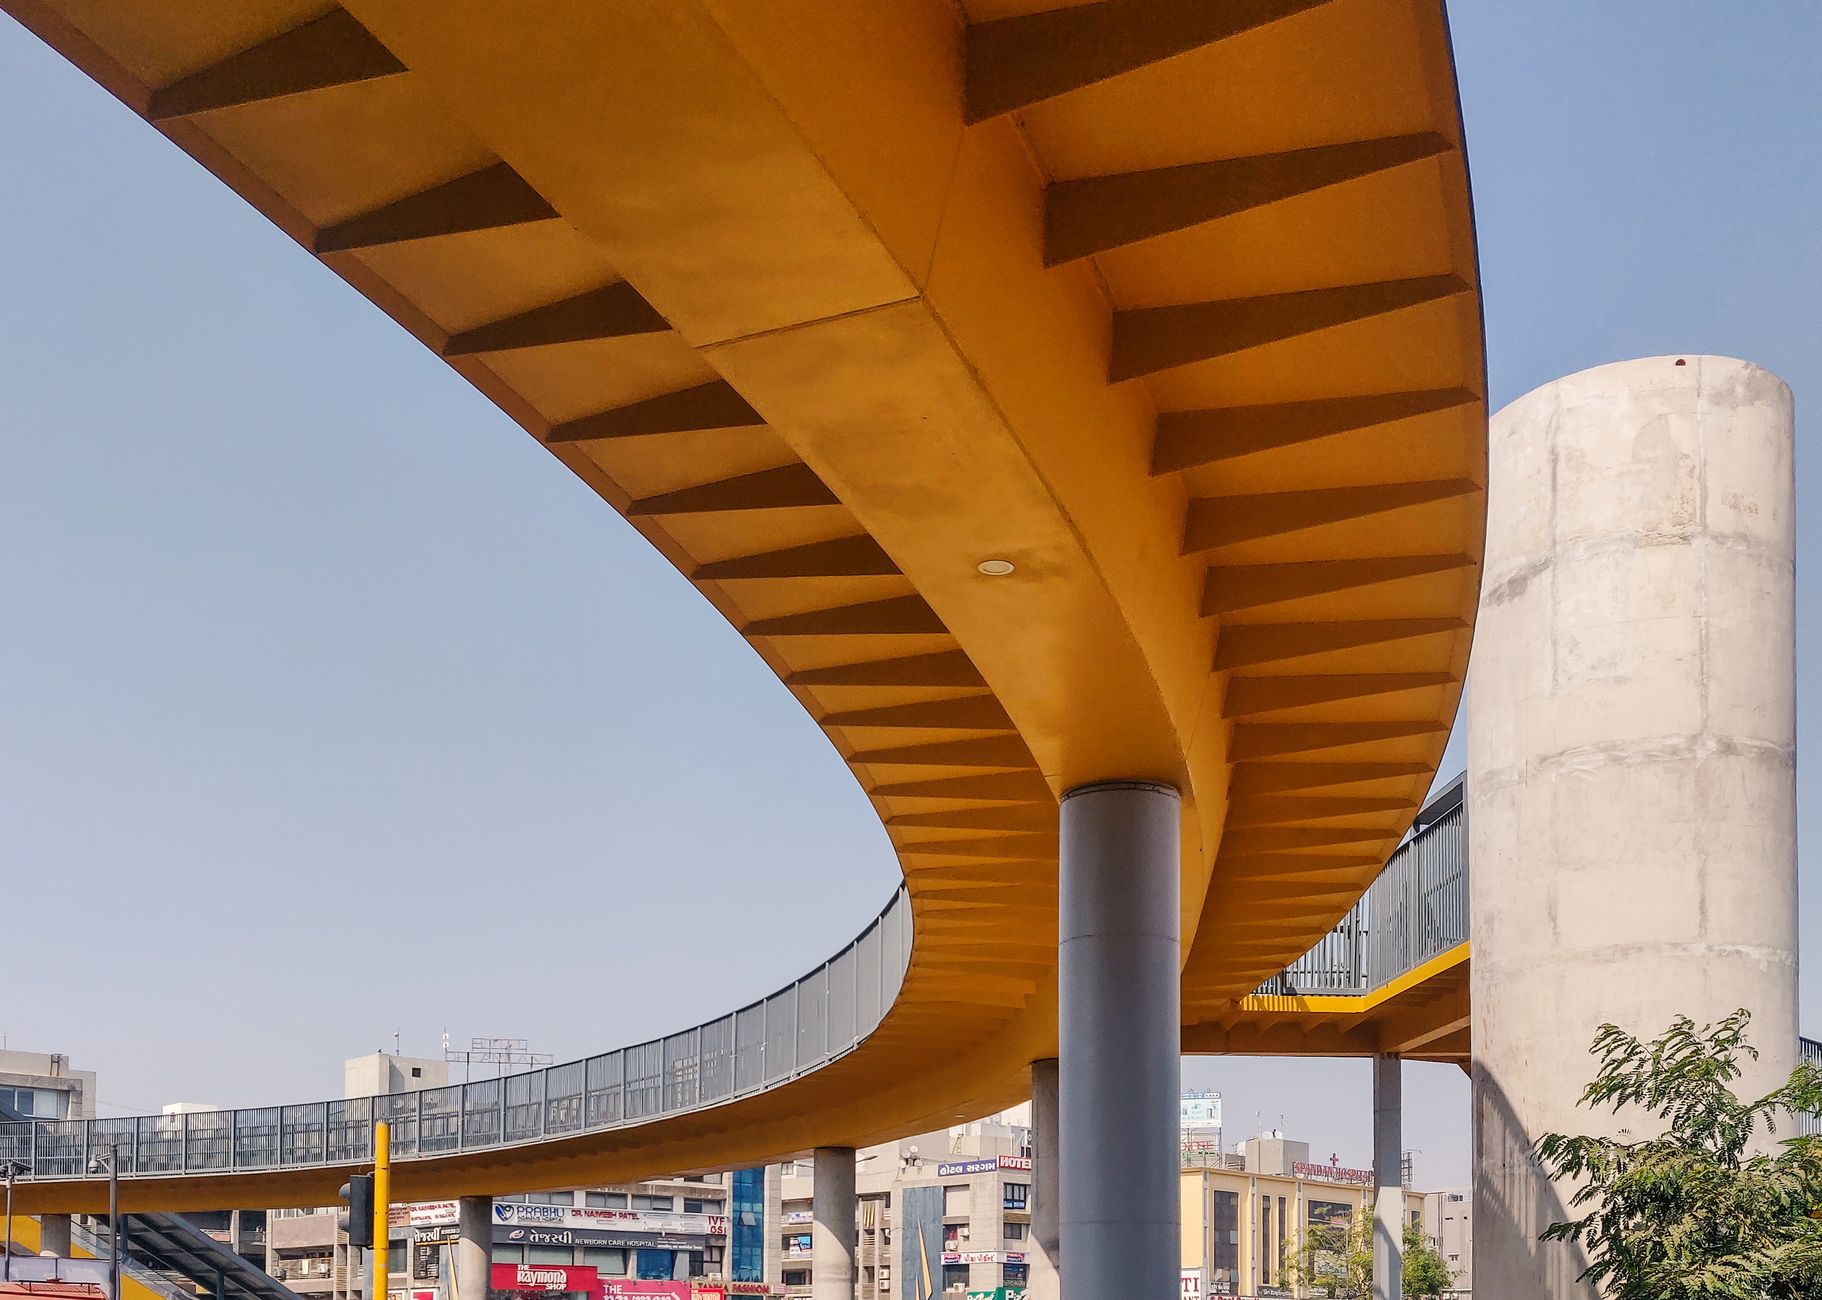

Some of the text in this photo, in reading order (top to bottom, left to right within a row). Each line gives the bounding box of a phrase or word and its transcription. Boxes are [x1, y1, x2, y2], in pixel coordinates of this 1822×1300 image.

[517, 1205, 565, 1217] PRABHU
[618, 1212, 640, 1220] PATEL
[708, 1216, 725, 1225] IVF
[603, 1284, 623, 1294] THE
[732, 1284, 769, 1293] FASHION
